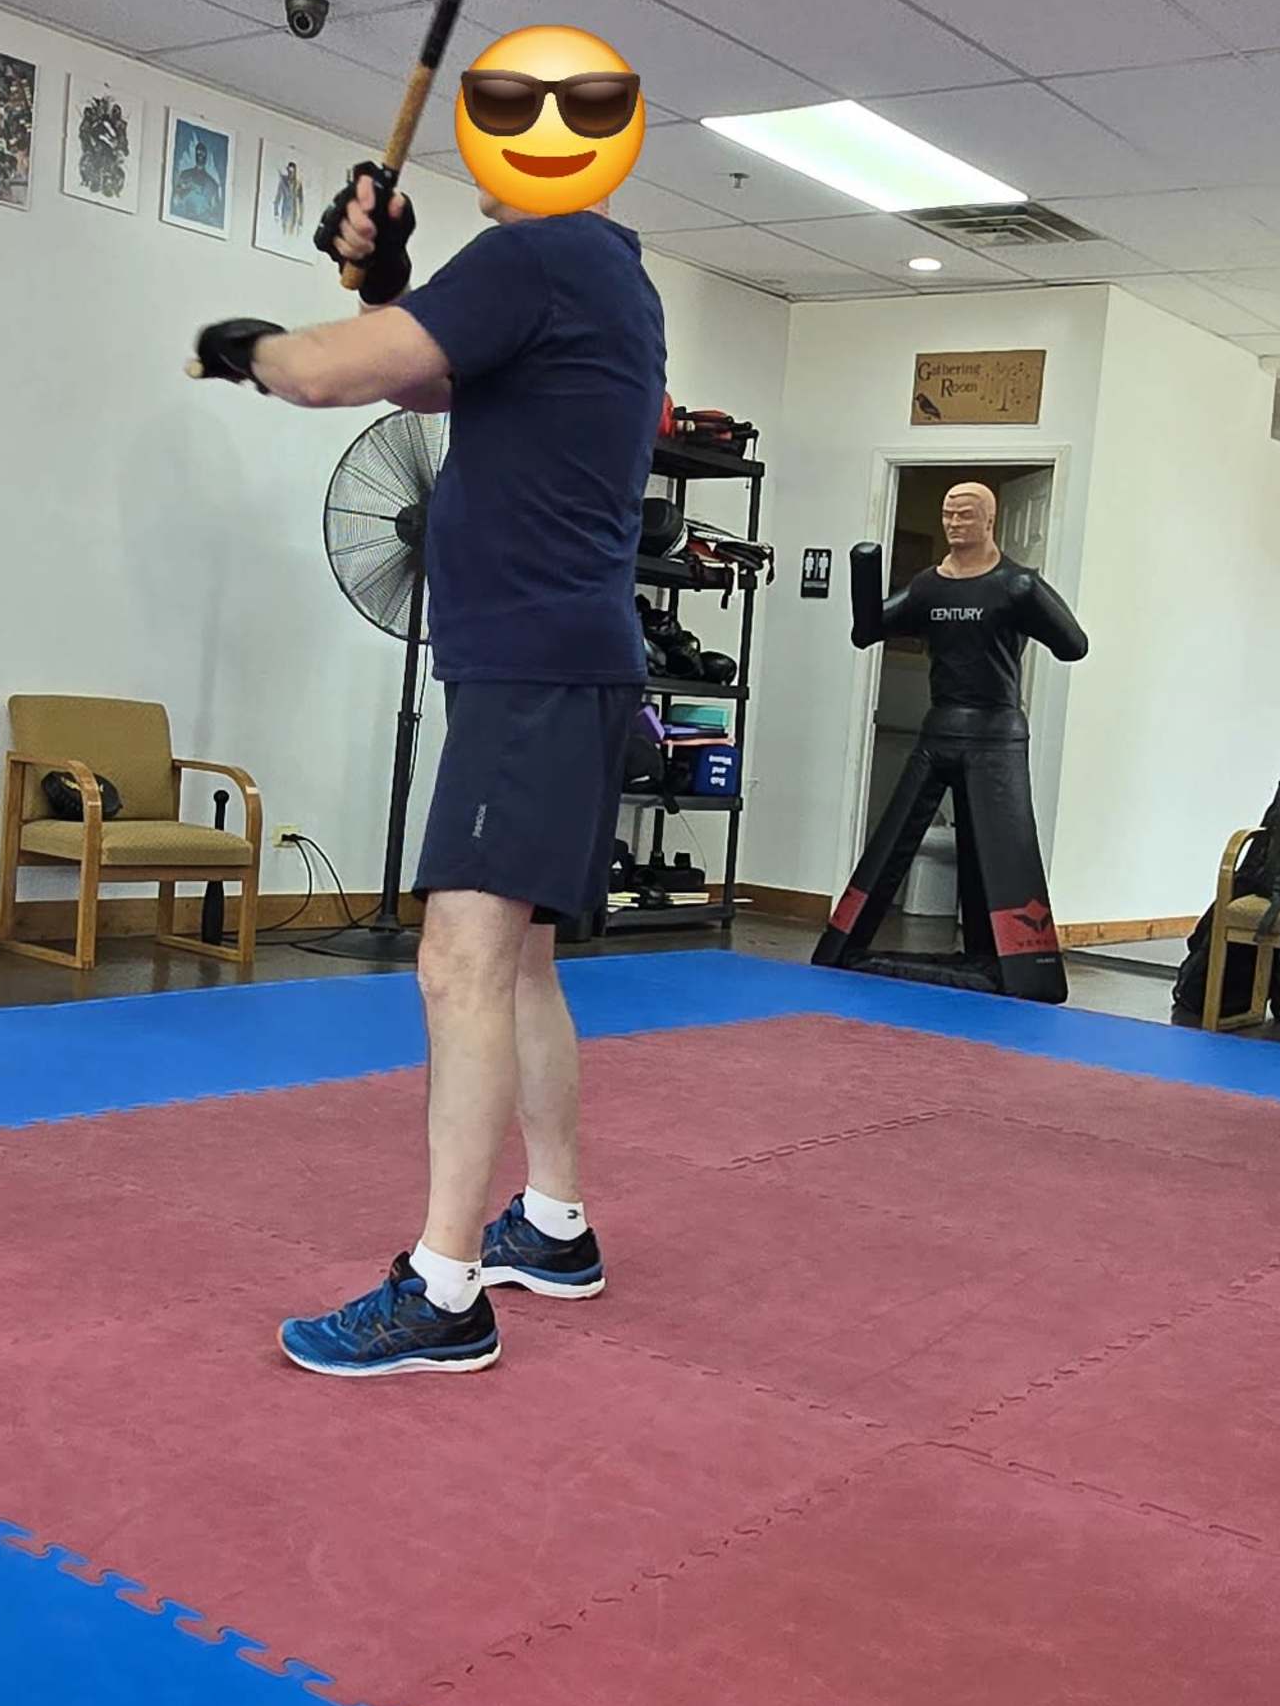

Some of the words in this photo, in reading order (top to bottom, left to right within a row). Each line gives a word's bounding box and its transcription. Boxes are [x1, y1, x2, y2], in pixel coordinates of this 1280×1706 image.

[918, 362, 981, 381] Gathering
[941, 378, 977, 397] Room
[930, 607, 984, 621] CENTURY
